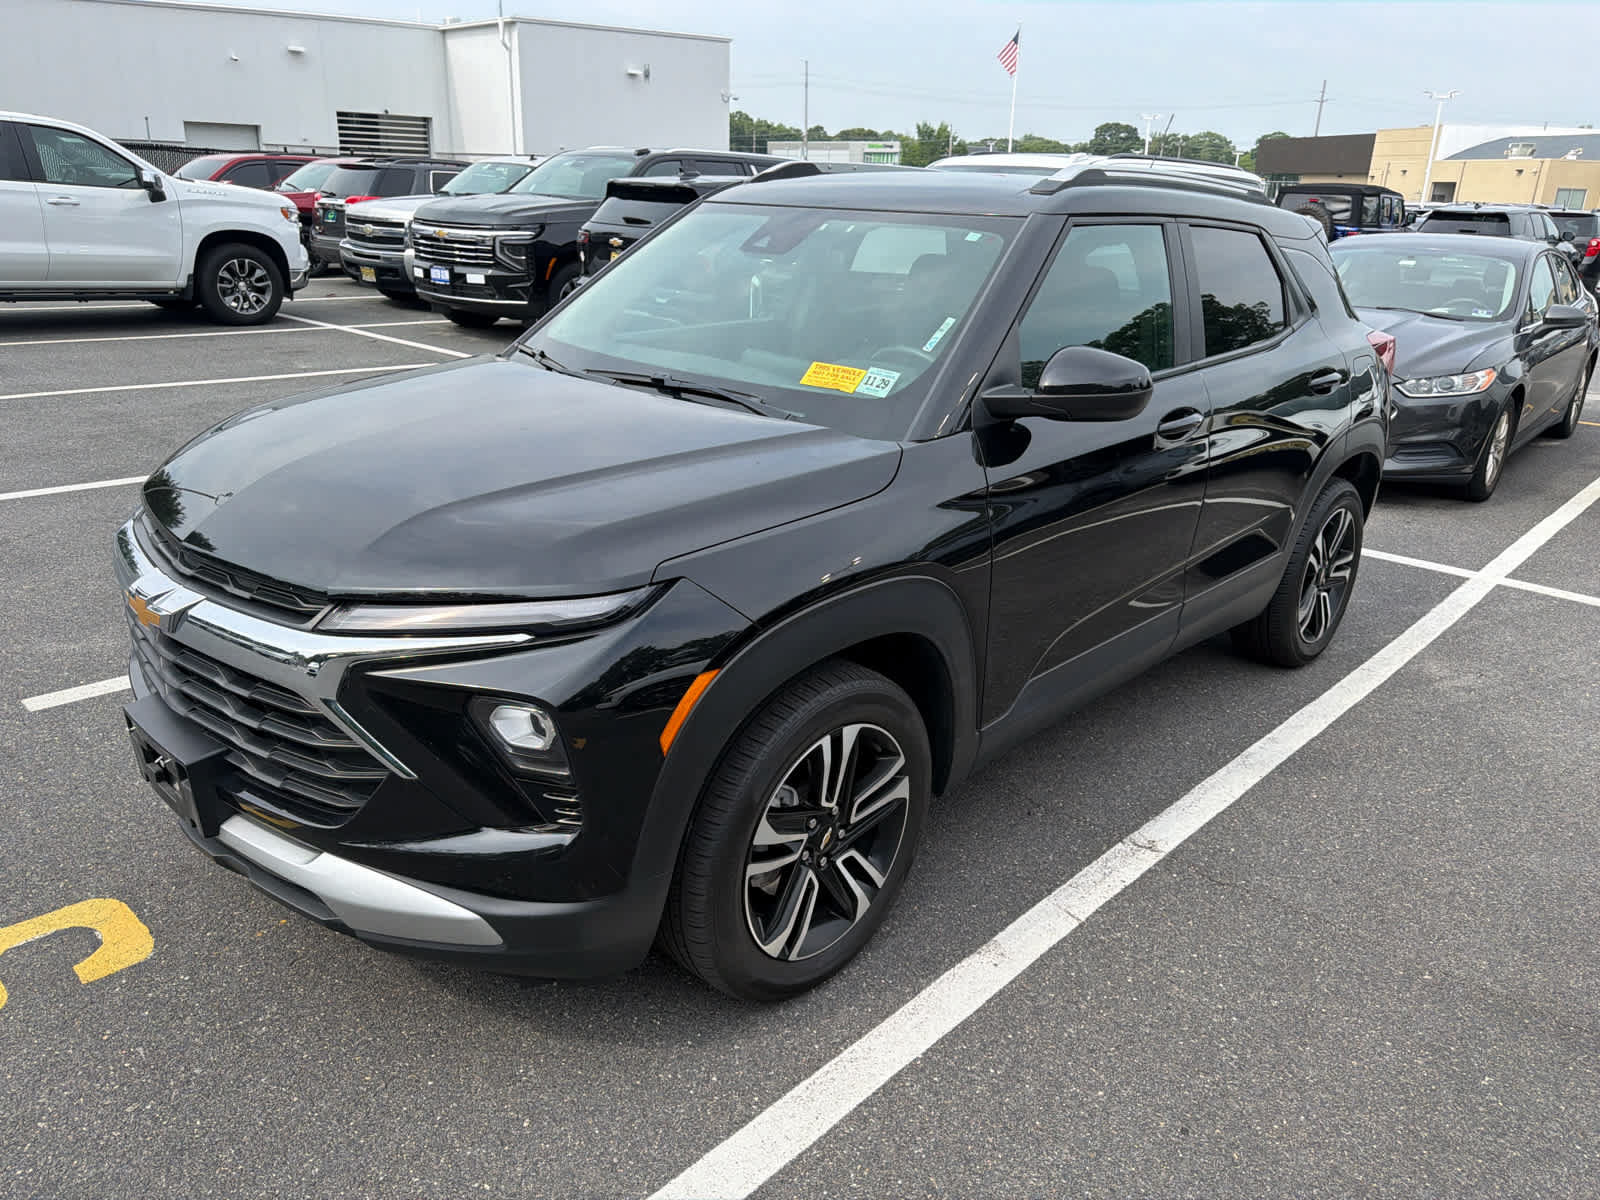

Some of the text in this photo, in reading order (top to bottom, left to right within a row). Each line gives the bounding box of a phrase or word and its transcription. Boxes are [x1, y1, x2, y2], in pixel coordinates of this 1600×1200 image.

[832, 366, 864, 376] VEHICLE
[864, 375, 876, 386] 11
[876, 378, 890, 390] 29
